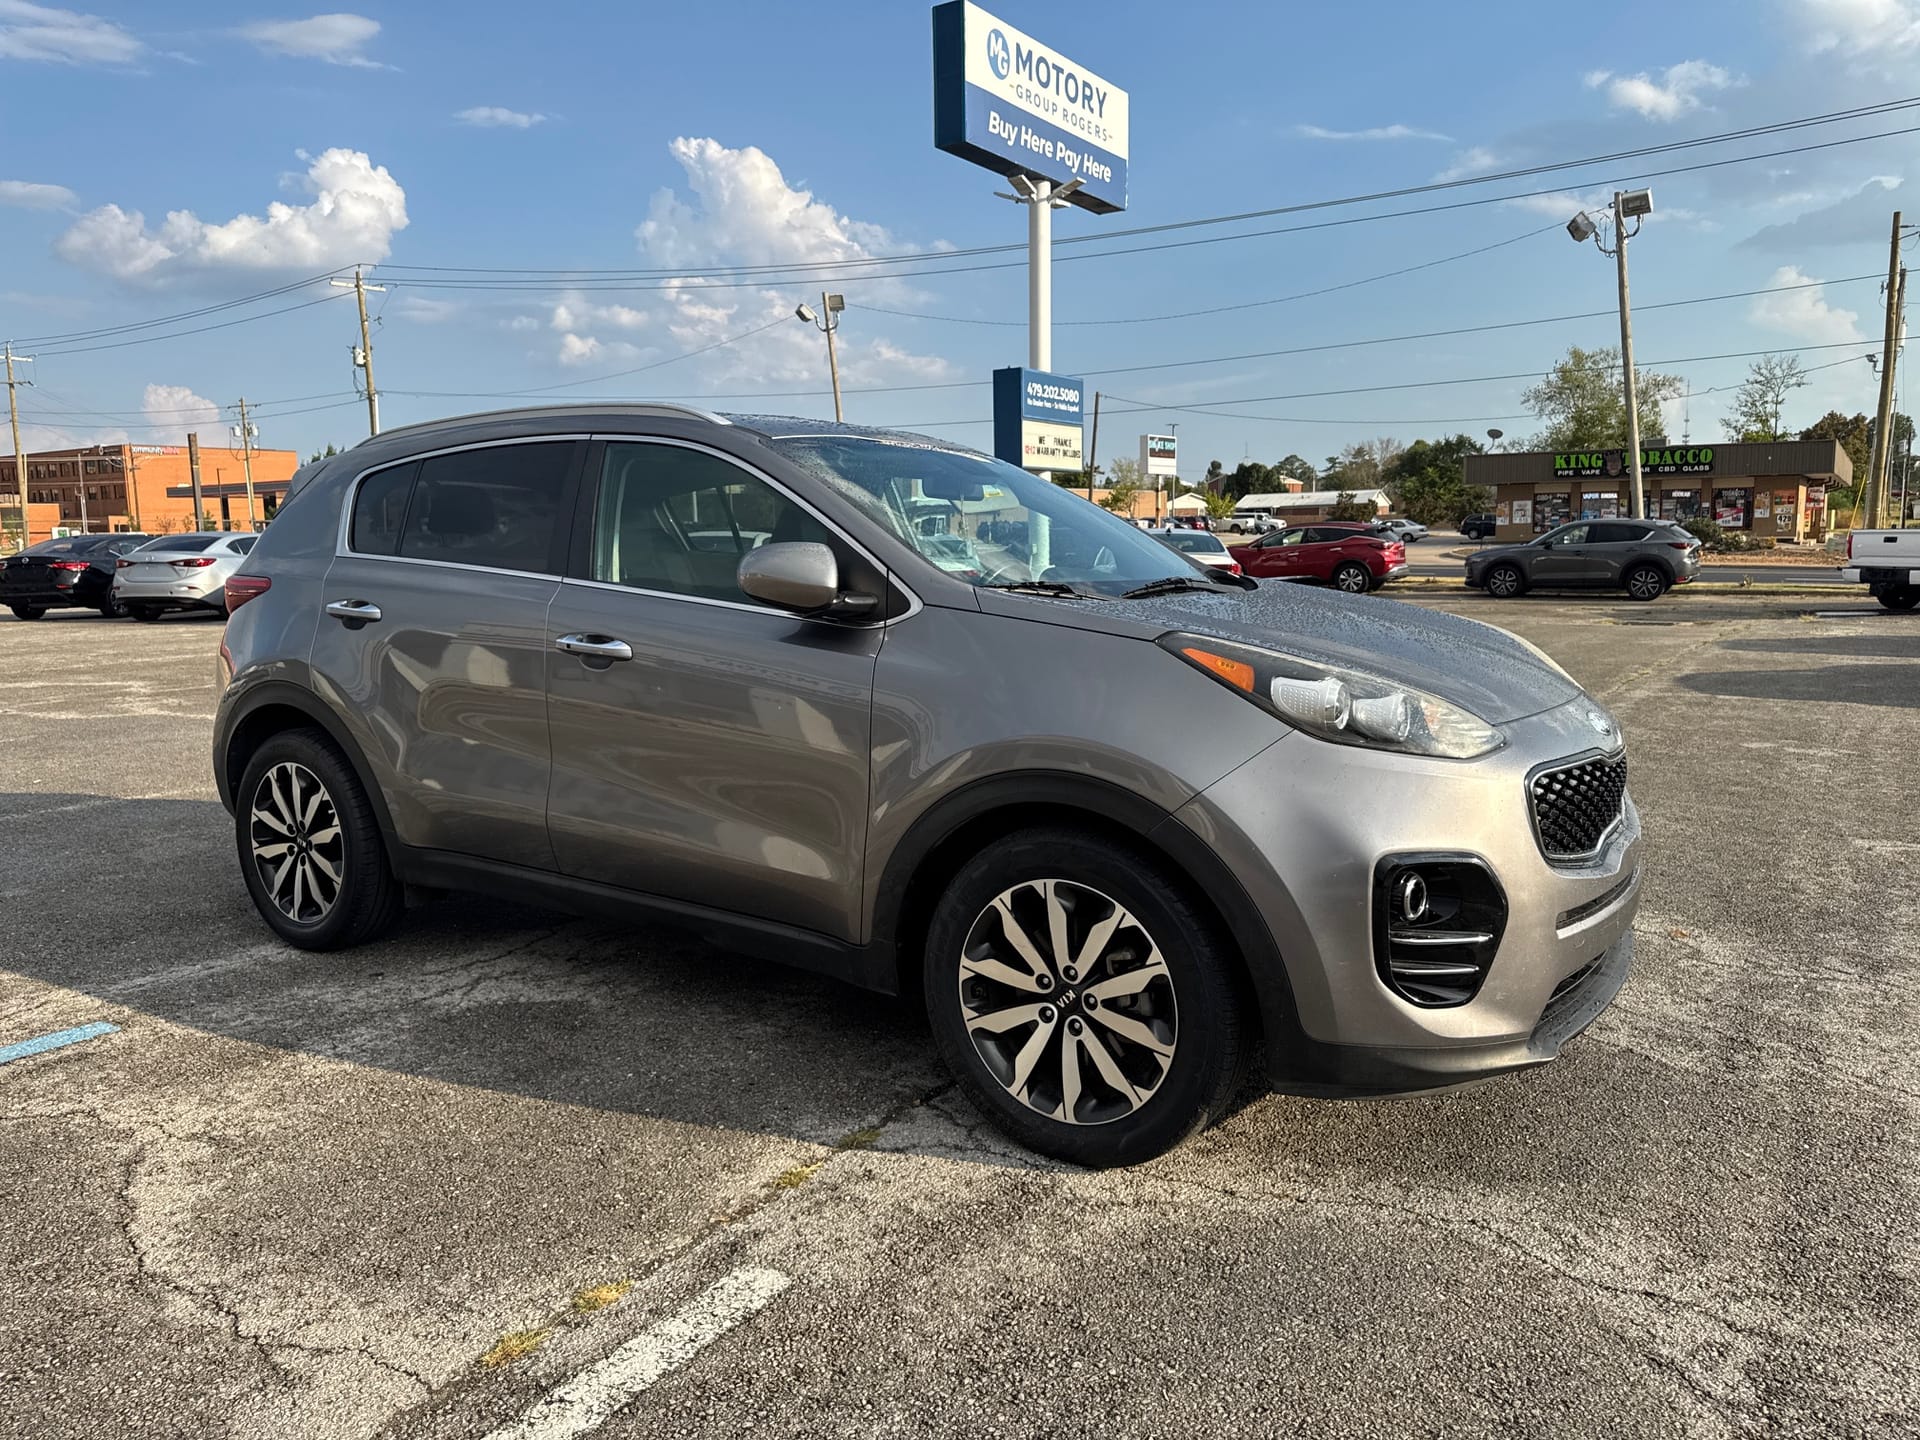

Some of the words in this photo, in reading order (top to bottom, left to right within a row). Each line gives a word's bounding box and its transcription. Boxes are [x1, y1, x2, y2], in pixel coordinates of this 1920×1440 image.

[1015, 42, 1107, 119] MOTORY
[1015, 84, 1058, 115] GROUP
[1062, 108, 1108, 142] ROGERS
[988, 110, 1018, 147] Buy
[1020, 125, 1054, 158] Here
[1056, 141, 1082, 174] Pay
[1083, 153, 1112, 183] Here
[1027, 382, 1079, 403] 479.202.5080
[1036, 446, 1061, 456] WARRANTY
[1038, 436, 1045, 445] WE
[1054, 437, 1072, 448] FINANCE
[1554, 453, 1603, 469] KING
[1622, 448, 1713, 466] TOBACCO
[1682, 464, 1710, 472] GLASS
[1056, 989, 1076, 1008] KIA
